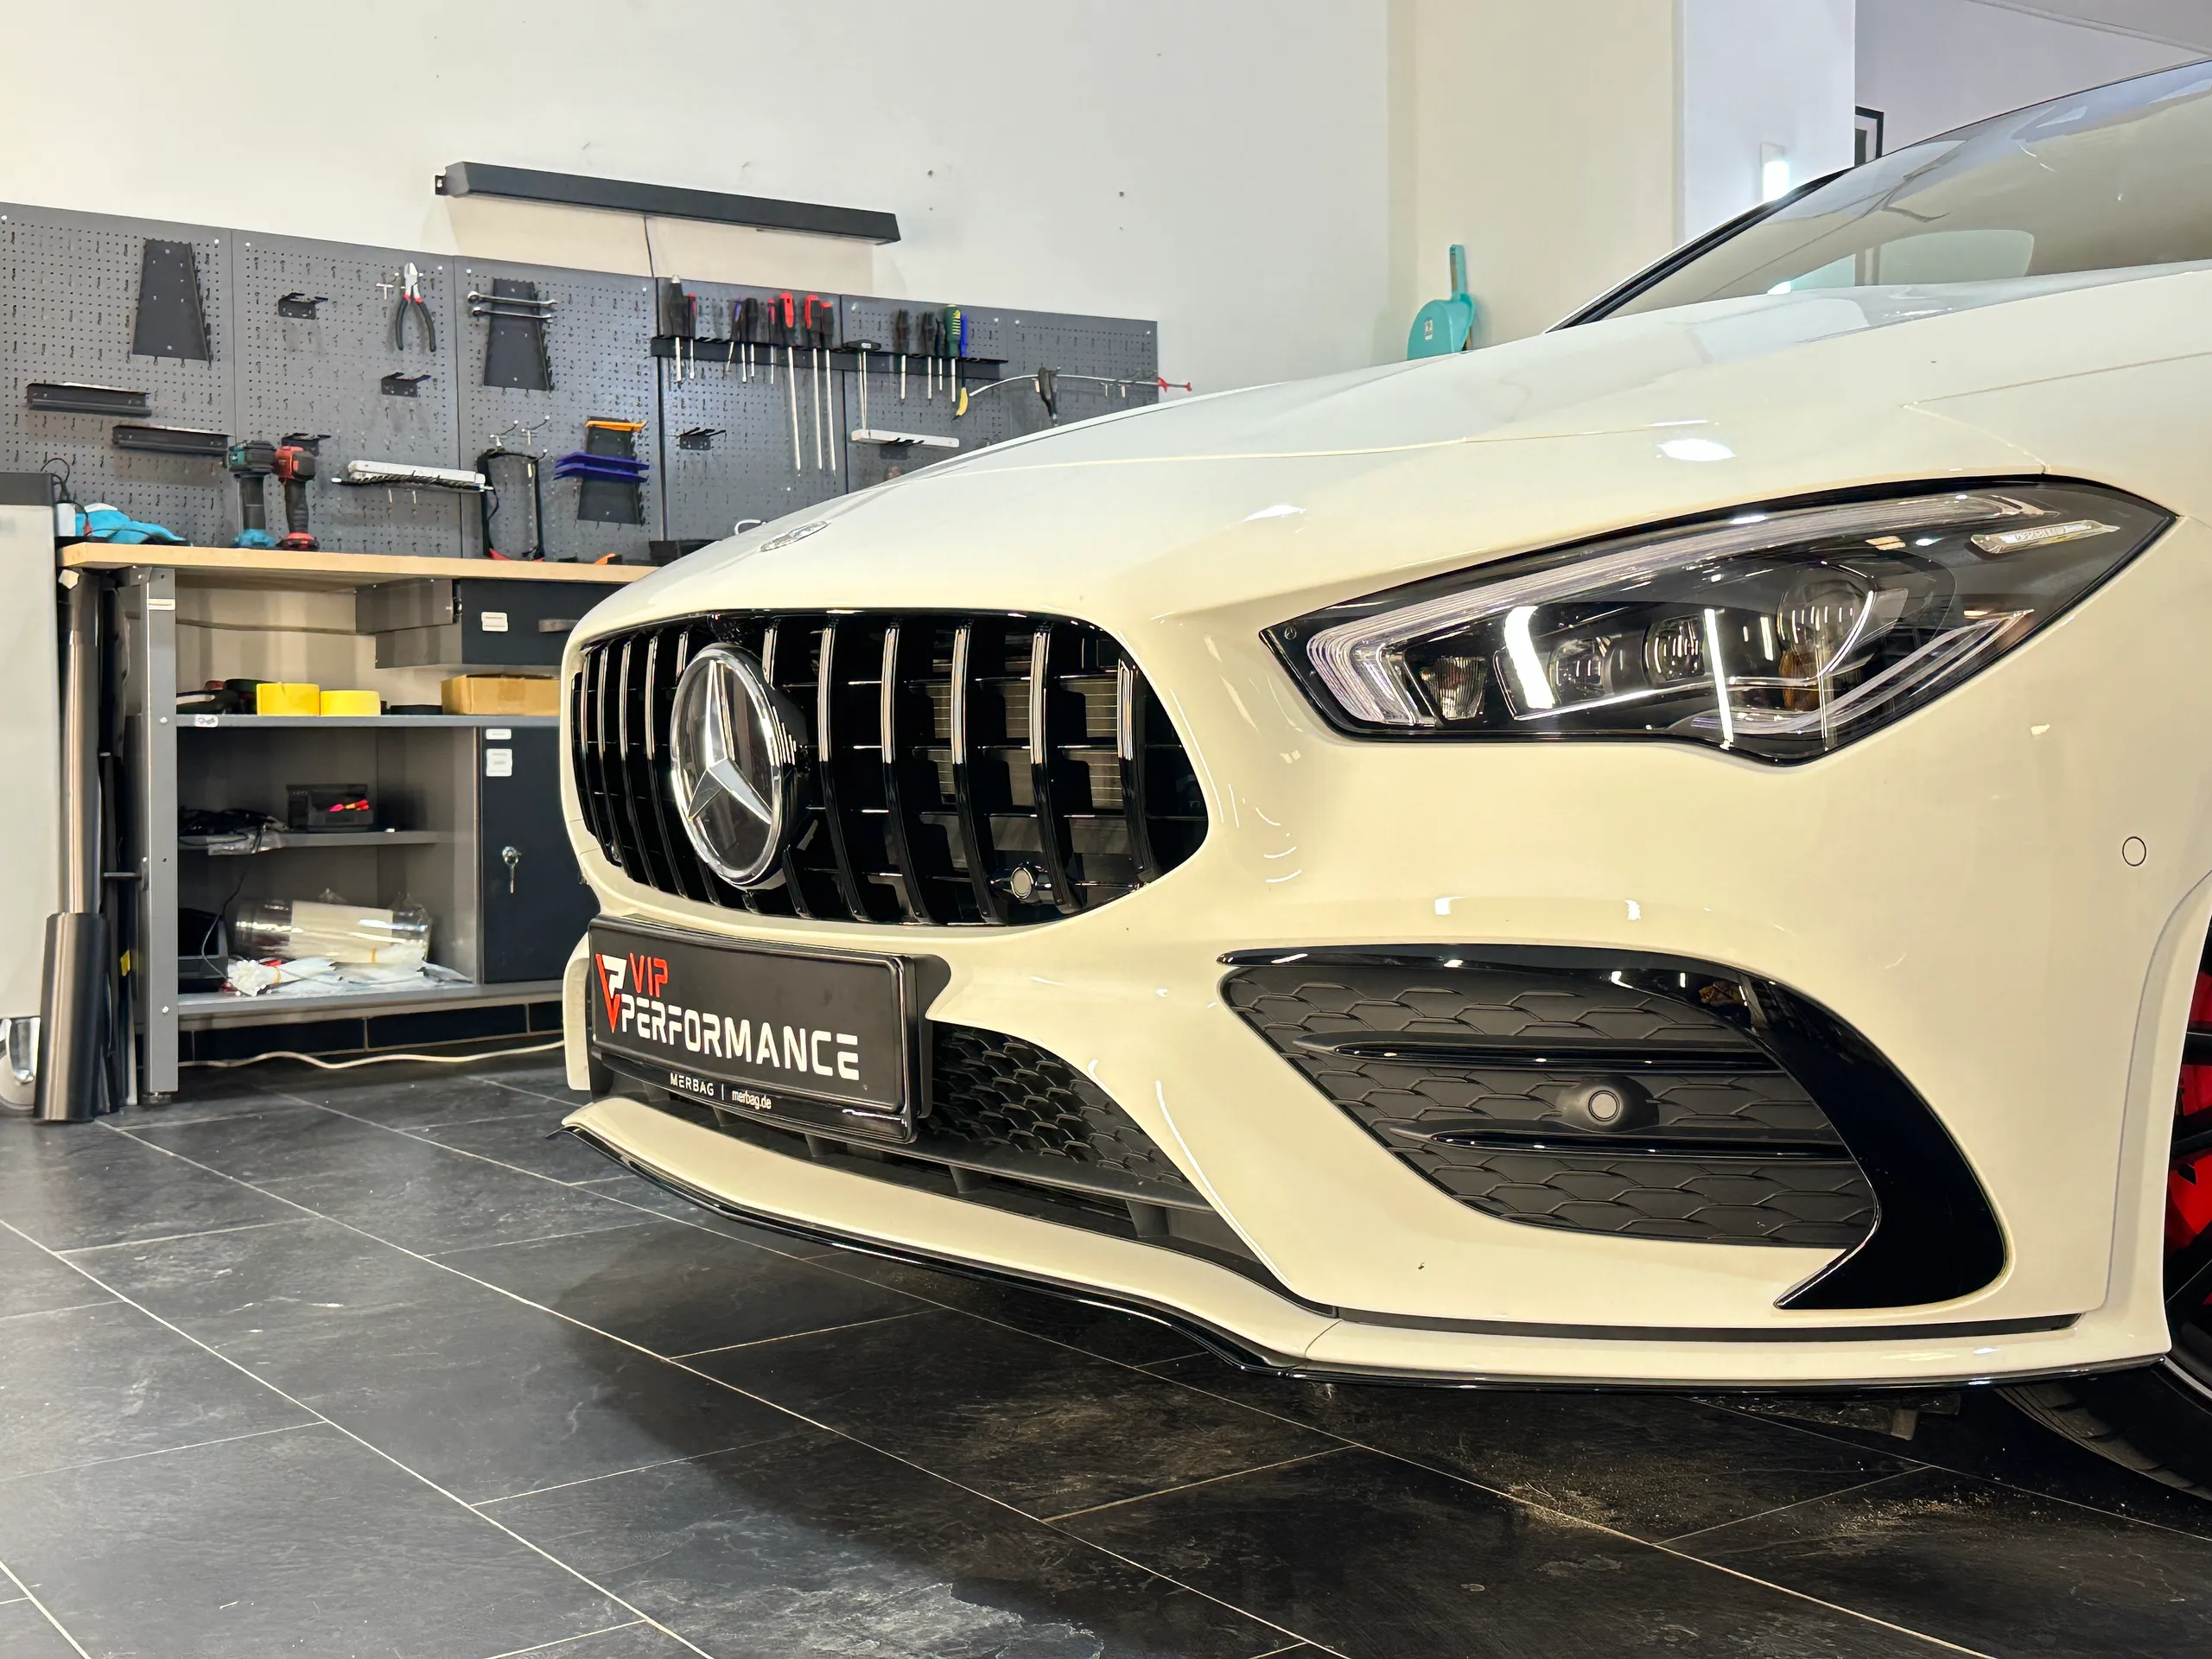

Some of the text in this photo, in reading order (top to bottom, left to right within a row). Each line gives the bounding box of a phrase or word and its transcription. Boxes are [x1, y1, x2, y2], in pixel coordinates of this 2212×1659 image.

[629, 952, 669, 998] VIP
[621, 993, 860, 1081] PERFORMANCE
[670, 1072, 715, 1096] MERBAG
[732, 1090, 772, 1110] merbag.de
